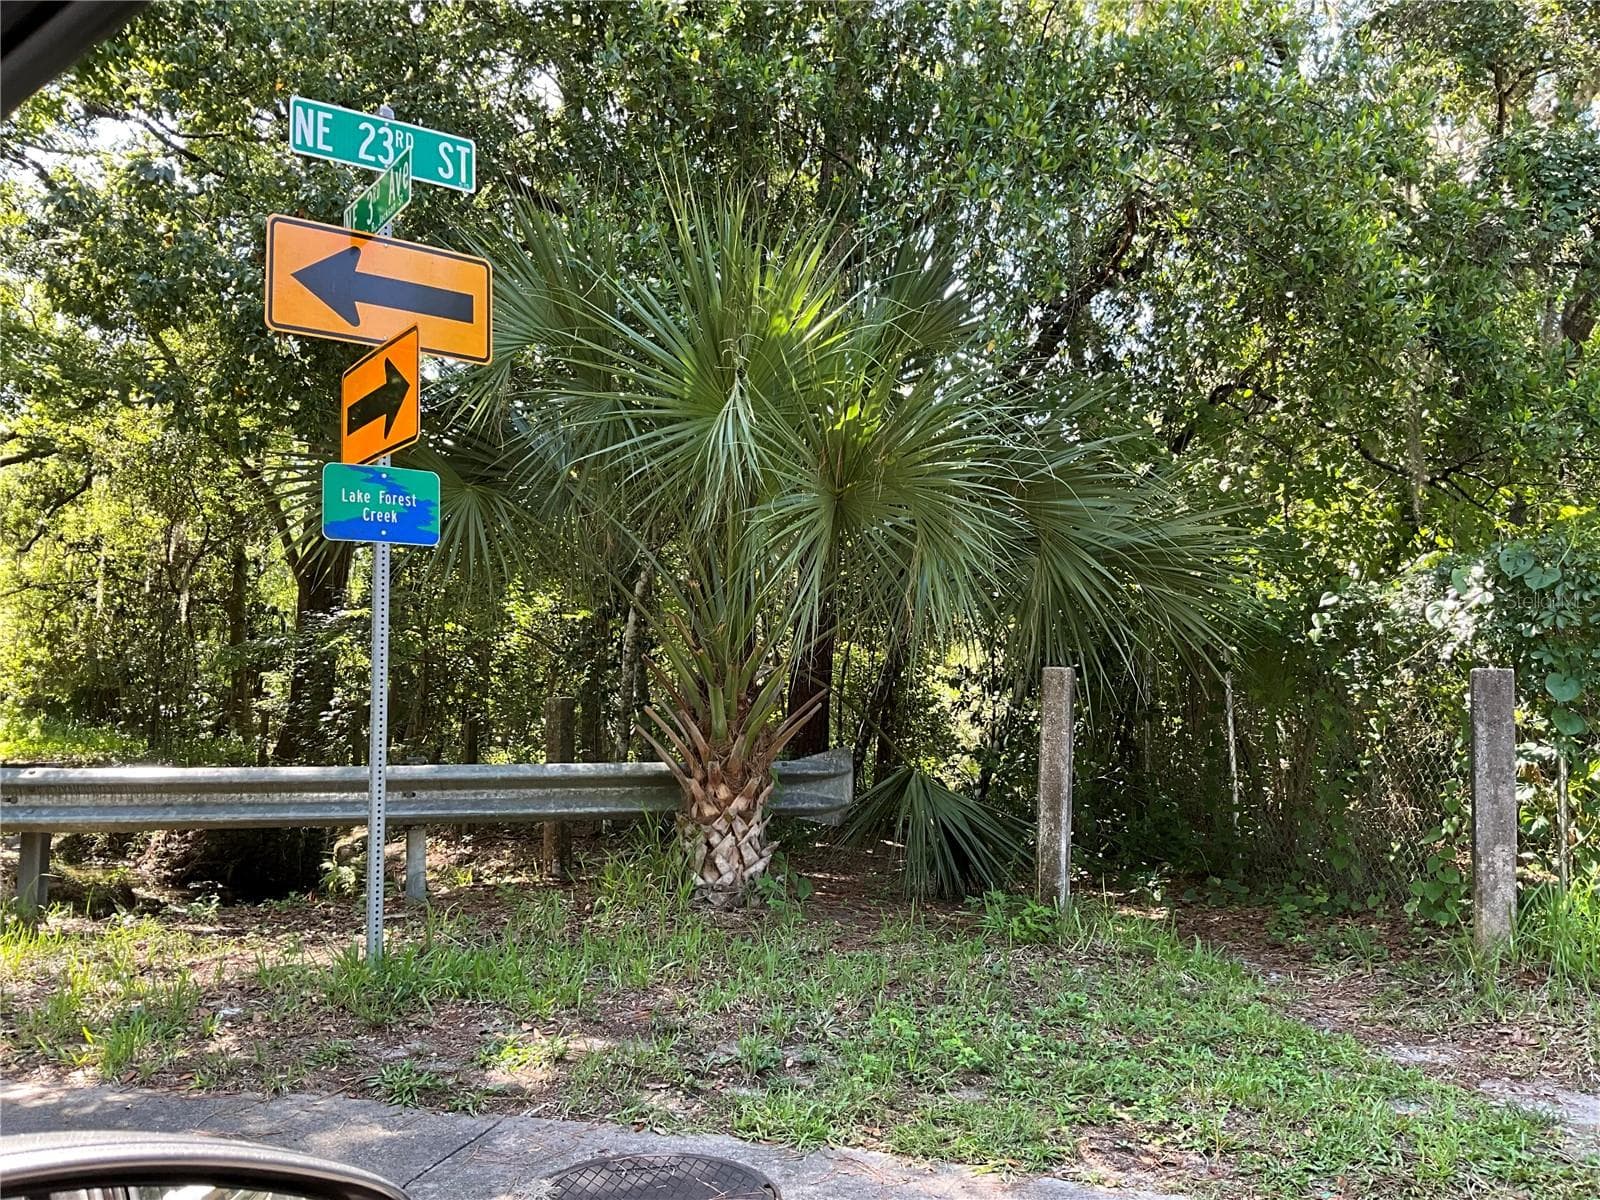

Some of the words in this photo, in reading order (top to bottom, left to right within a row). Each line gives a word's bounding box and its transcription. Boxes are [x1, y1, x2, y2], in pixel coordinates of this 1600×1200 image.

[295, 106, 333, 152] NE
[358, 122, 414, 165] 23RD
[437, 142, 471, 183] ST
[388, 161, 409, 205] Ave
[341, 488, 371, 503] Lake
[379, 490, 417, 507] Forest
[363, 507, 398, 523] Creek
